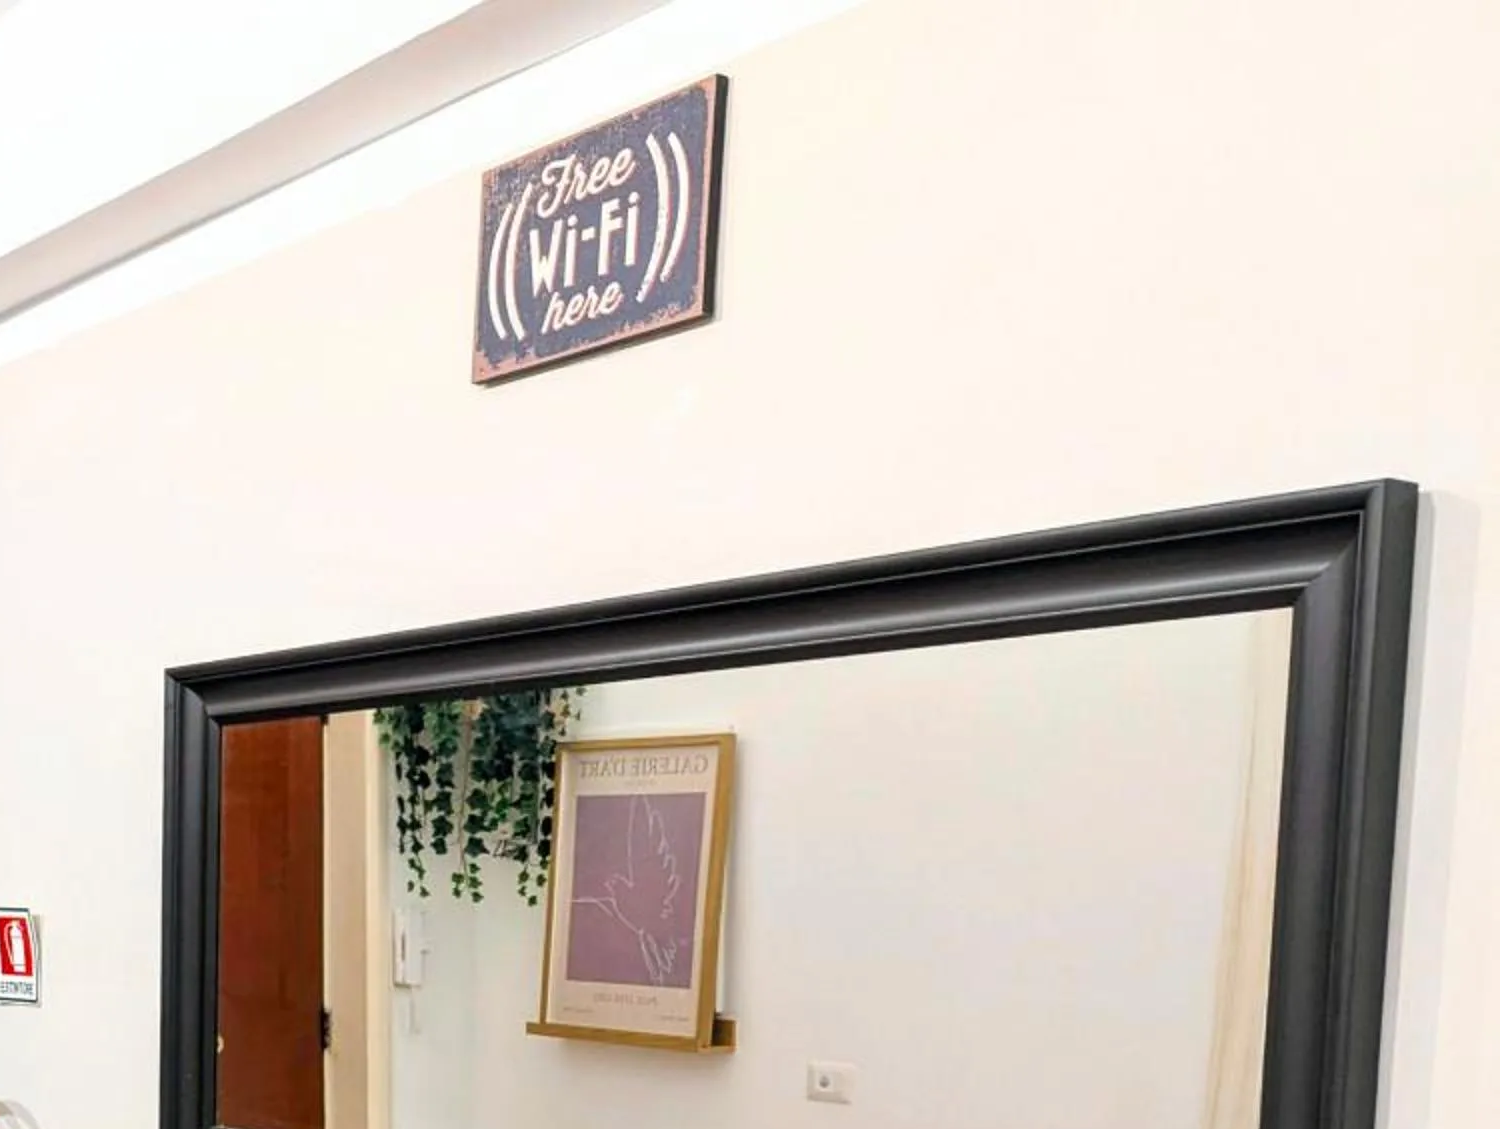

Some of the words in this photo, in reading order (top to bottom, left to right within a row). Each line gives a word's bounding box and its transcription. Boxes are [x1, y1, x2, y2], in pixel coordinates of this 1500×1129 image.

[537, 146, 637, 220] Free
[528, 191, 642, 298] Wi-Fi
[540, 280, 625, 336] here
